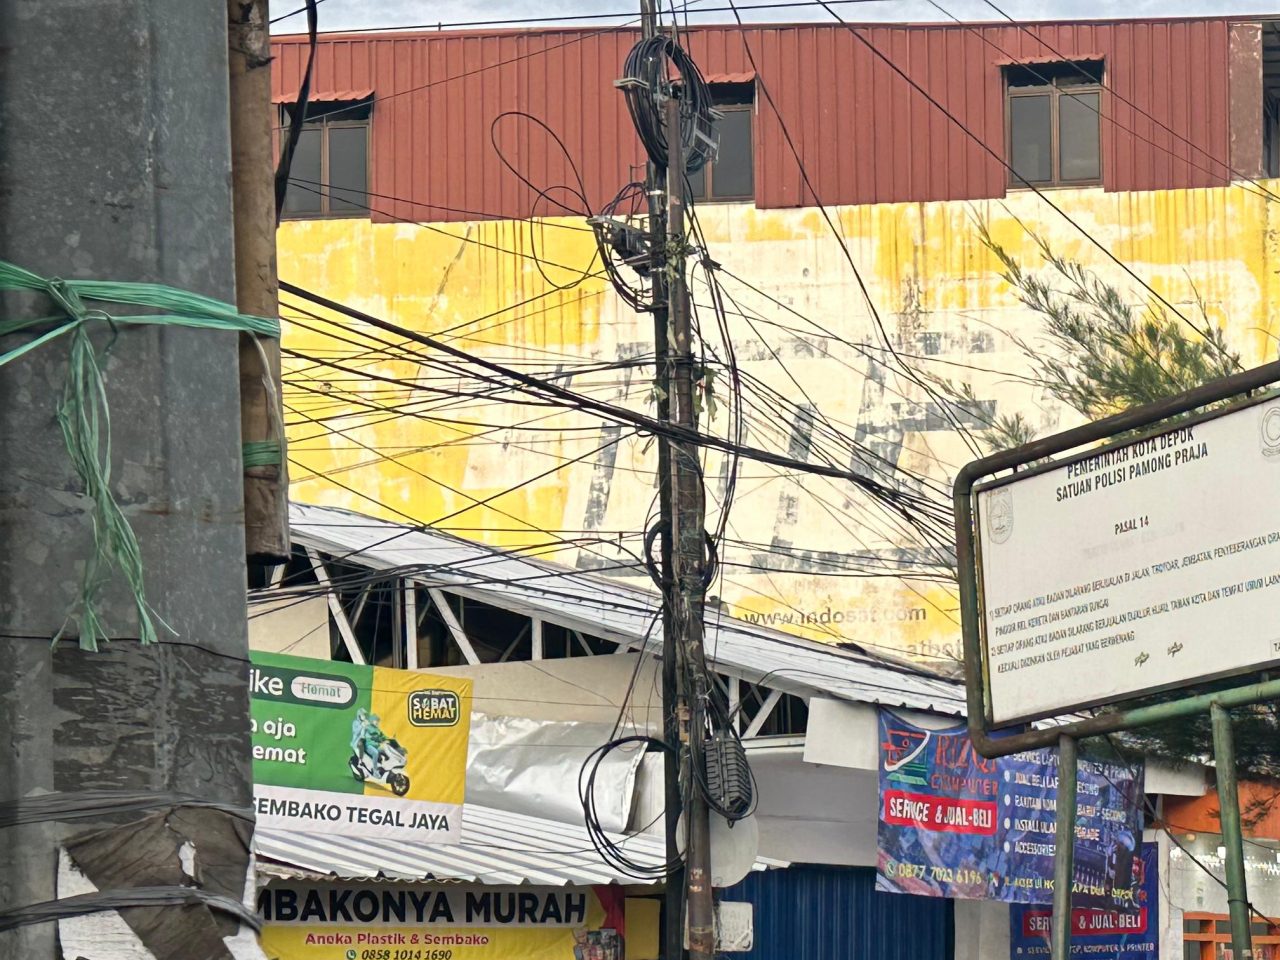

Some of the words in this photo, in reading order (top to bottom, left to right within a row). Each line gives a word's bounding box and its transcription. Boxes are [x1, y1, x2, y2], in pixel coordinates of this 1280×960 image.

[1132, 438, 1157, 459] KOTA
[1160, 427, 1194, 450] DEPOK
[1056, 477, 1092, 502] SATUAN
[1095, 467, 1126, 490] POLISI
[1129, 453, 1172, 480] PAMONG
[1175, 442, 1209, 465] PRAJA
[1114, 522, 1138, 535] PASAL
[1140, 515, 1150, 528] 14
[301, 682, 343, 698] Hemat
[413, 707, 456, 721] HEMAT
[263, 718, 296, 740] aja
[346, 806, 405, 828] TEGAL
[409, 812, 450, 832] JAYA
[889, 797, 931, 822] SERVICE
[465, 889, 586, 924] MURAH
[1079, 915, 1086, 930] &
[305, 932, 352, 945] Aneka
[357, 932, 406, 946] Plastik
[409, 933, 419, 945] &
[424, 932, 489, 946] Sembako
[361, 949, 391, 960] 0858
[393, 949, 422, 960] 1014
[424, 949, 452, 960] 1690
